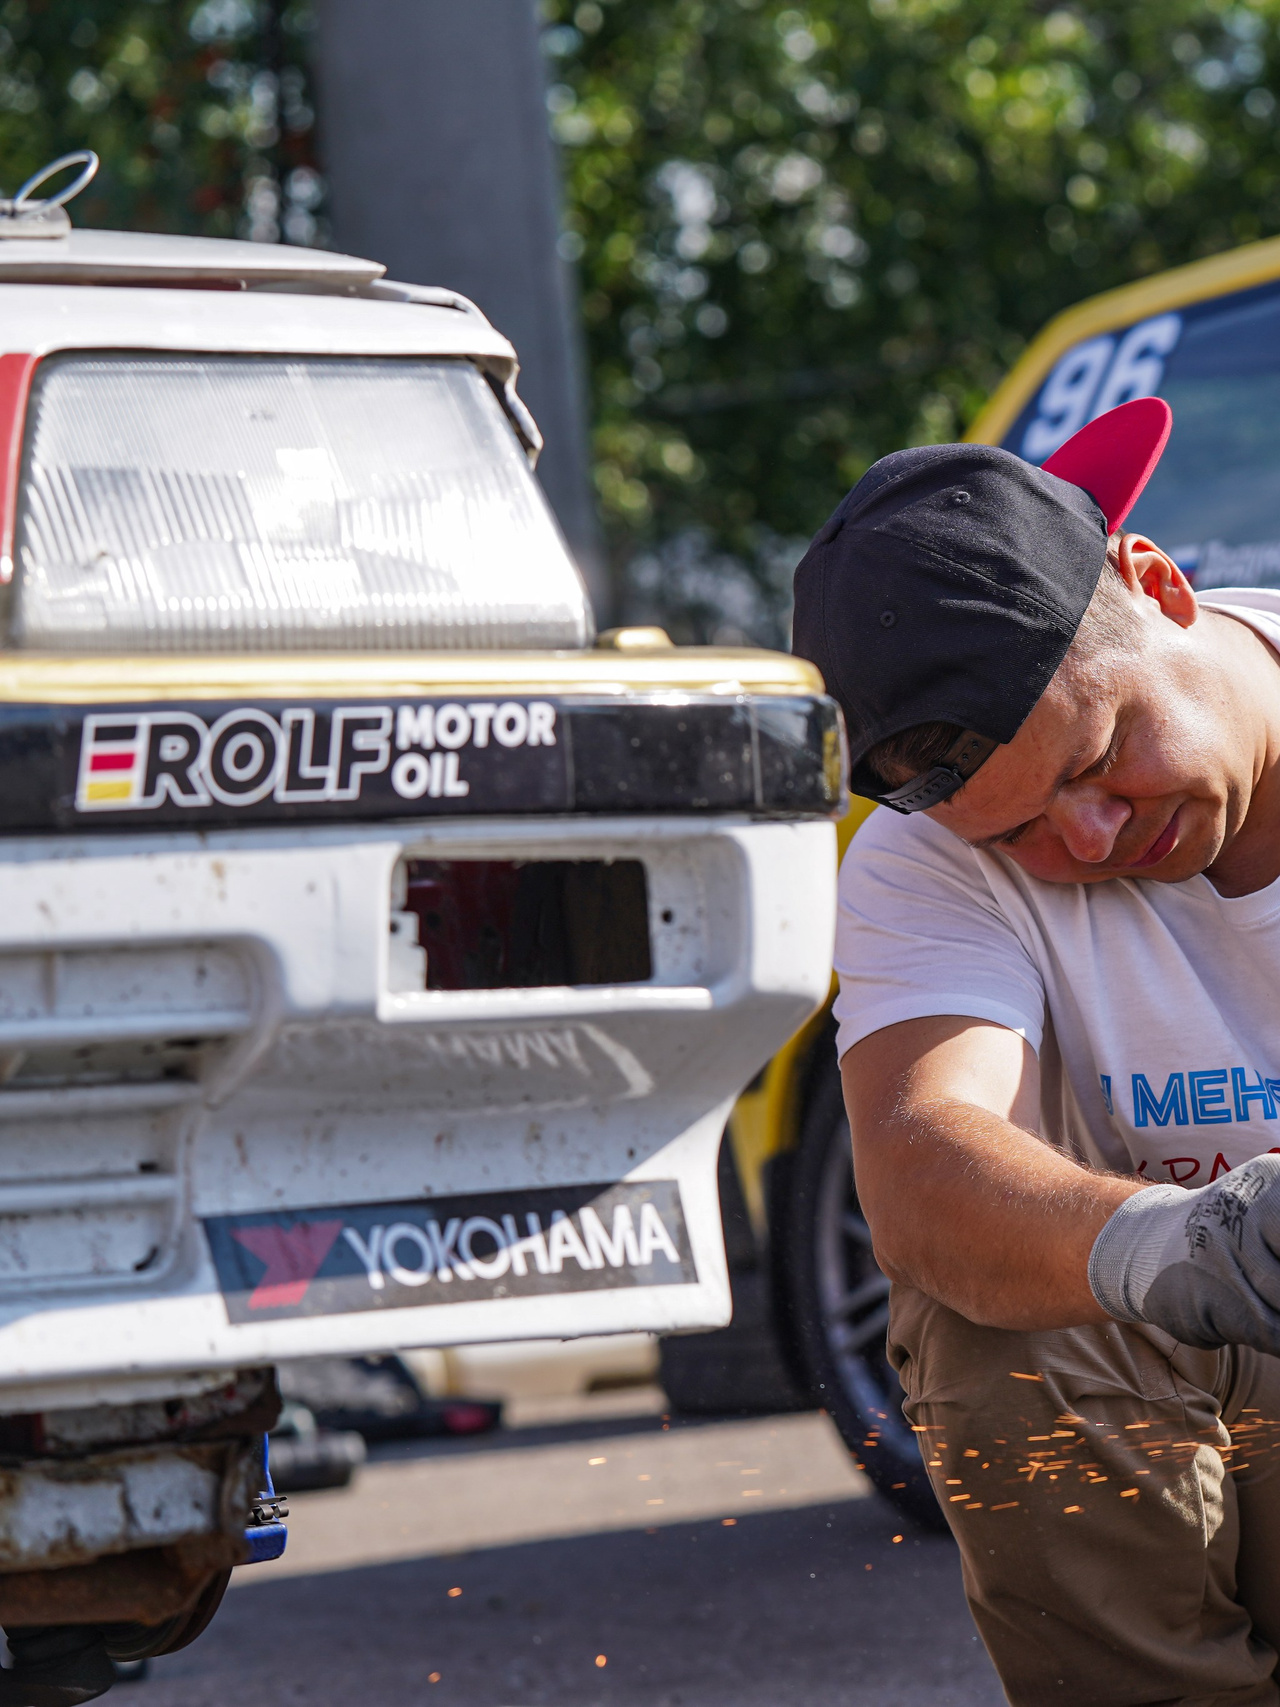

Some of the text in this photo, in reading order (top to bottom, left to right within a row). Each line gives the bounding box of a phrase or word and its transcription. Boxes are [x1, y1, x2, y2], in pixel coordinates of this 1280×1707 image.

[1020, 311, 1183, 458] 96
[138, 701, 556, 807] ROLF MOTOR
[391, 753, 469, 799] OIL
[342, 1203, 680, 1290] YOKOHAMA
